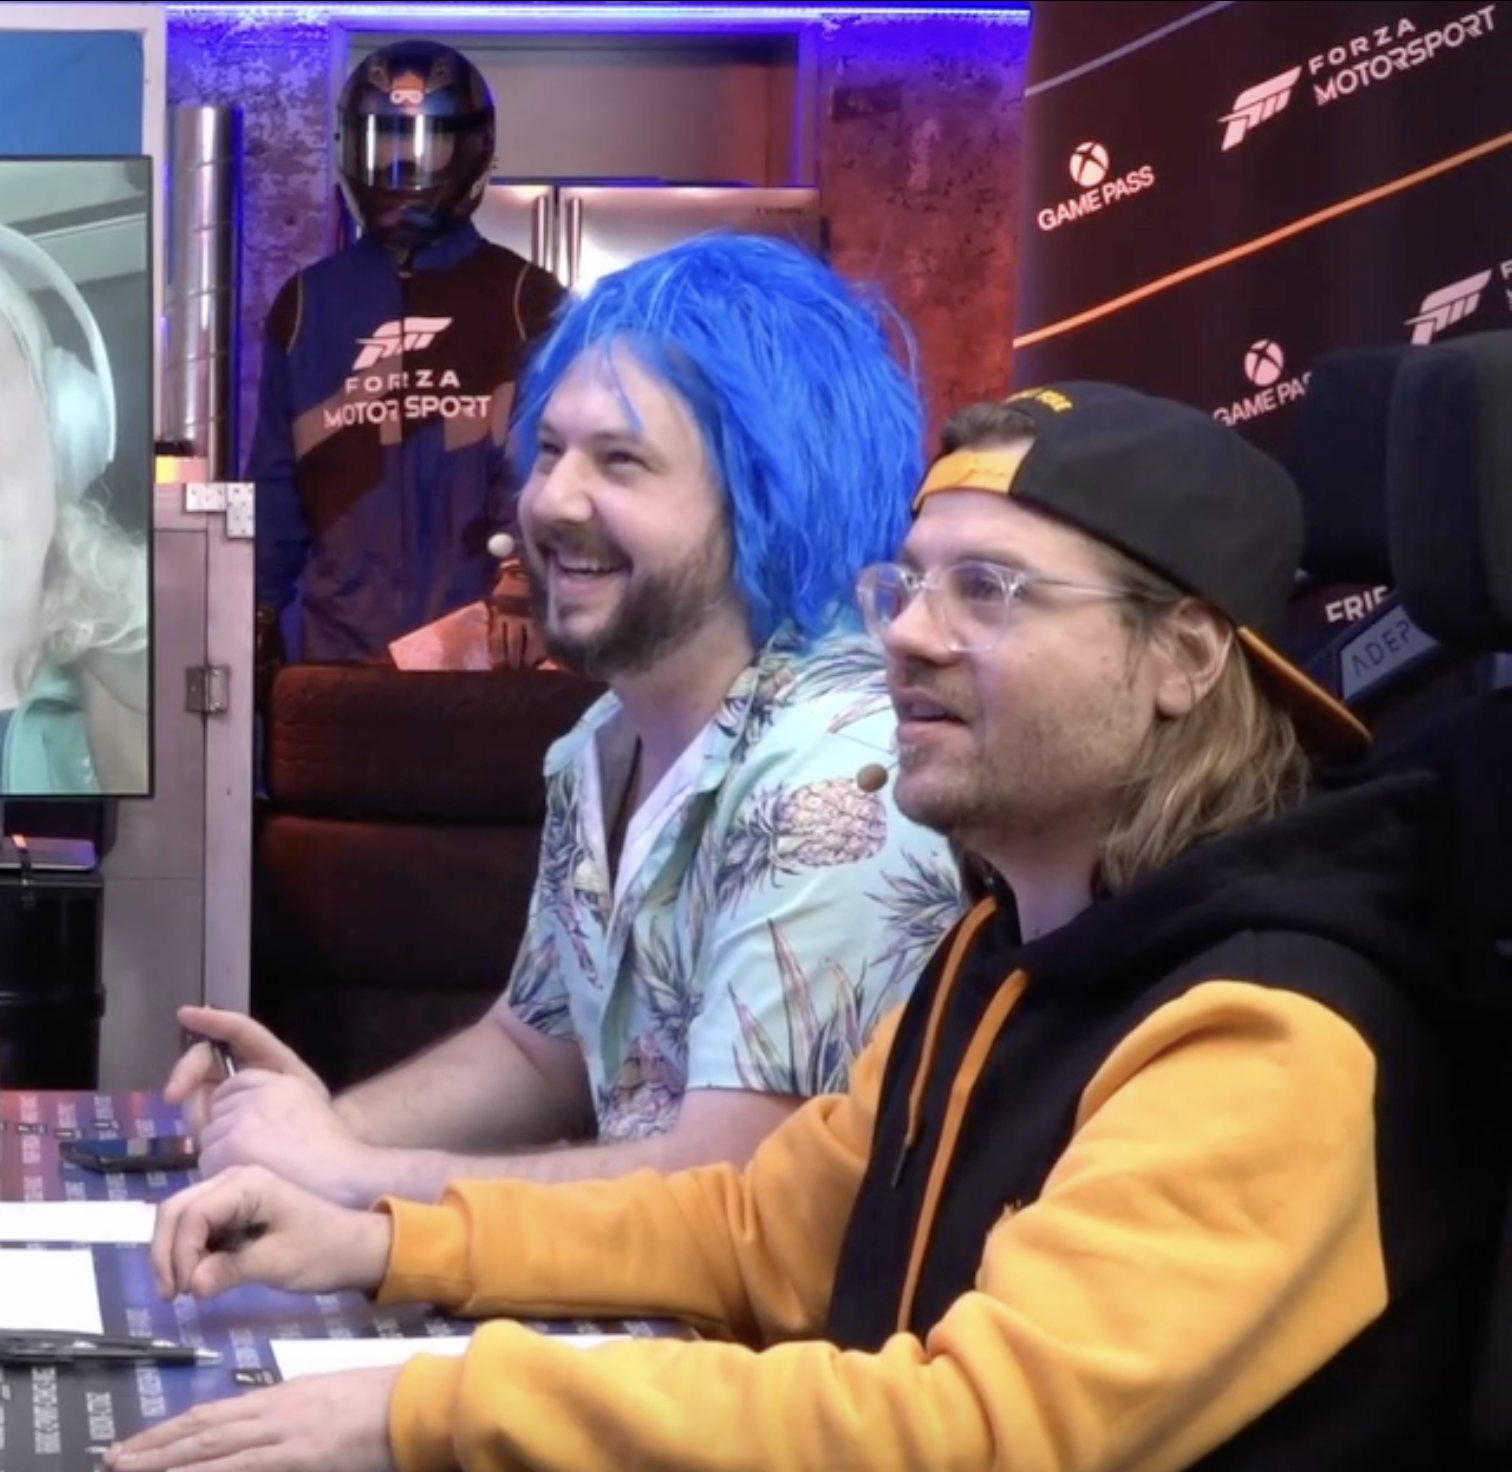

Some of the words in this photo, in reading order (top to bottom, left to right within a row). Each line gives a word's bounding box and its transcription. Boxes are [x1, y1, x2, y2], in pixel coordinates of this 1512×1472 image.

[1308, 17, 1416, 75] FORZA
[1313, 4, 1495, 106] MOTORSPORT
[1038, 188, 1103, 231] GAME
[1102, 165, 1155, 205] PASS
[345, 369, 460, 394] FORZA
[323, 395, 492, 429] MOTORSPORT
[1213, 387, 1277, 427] GAME
